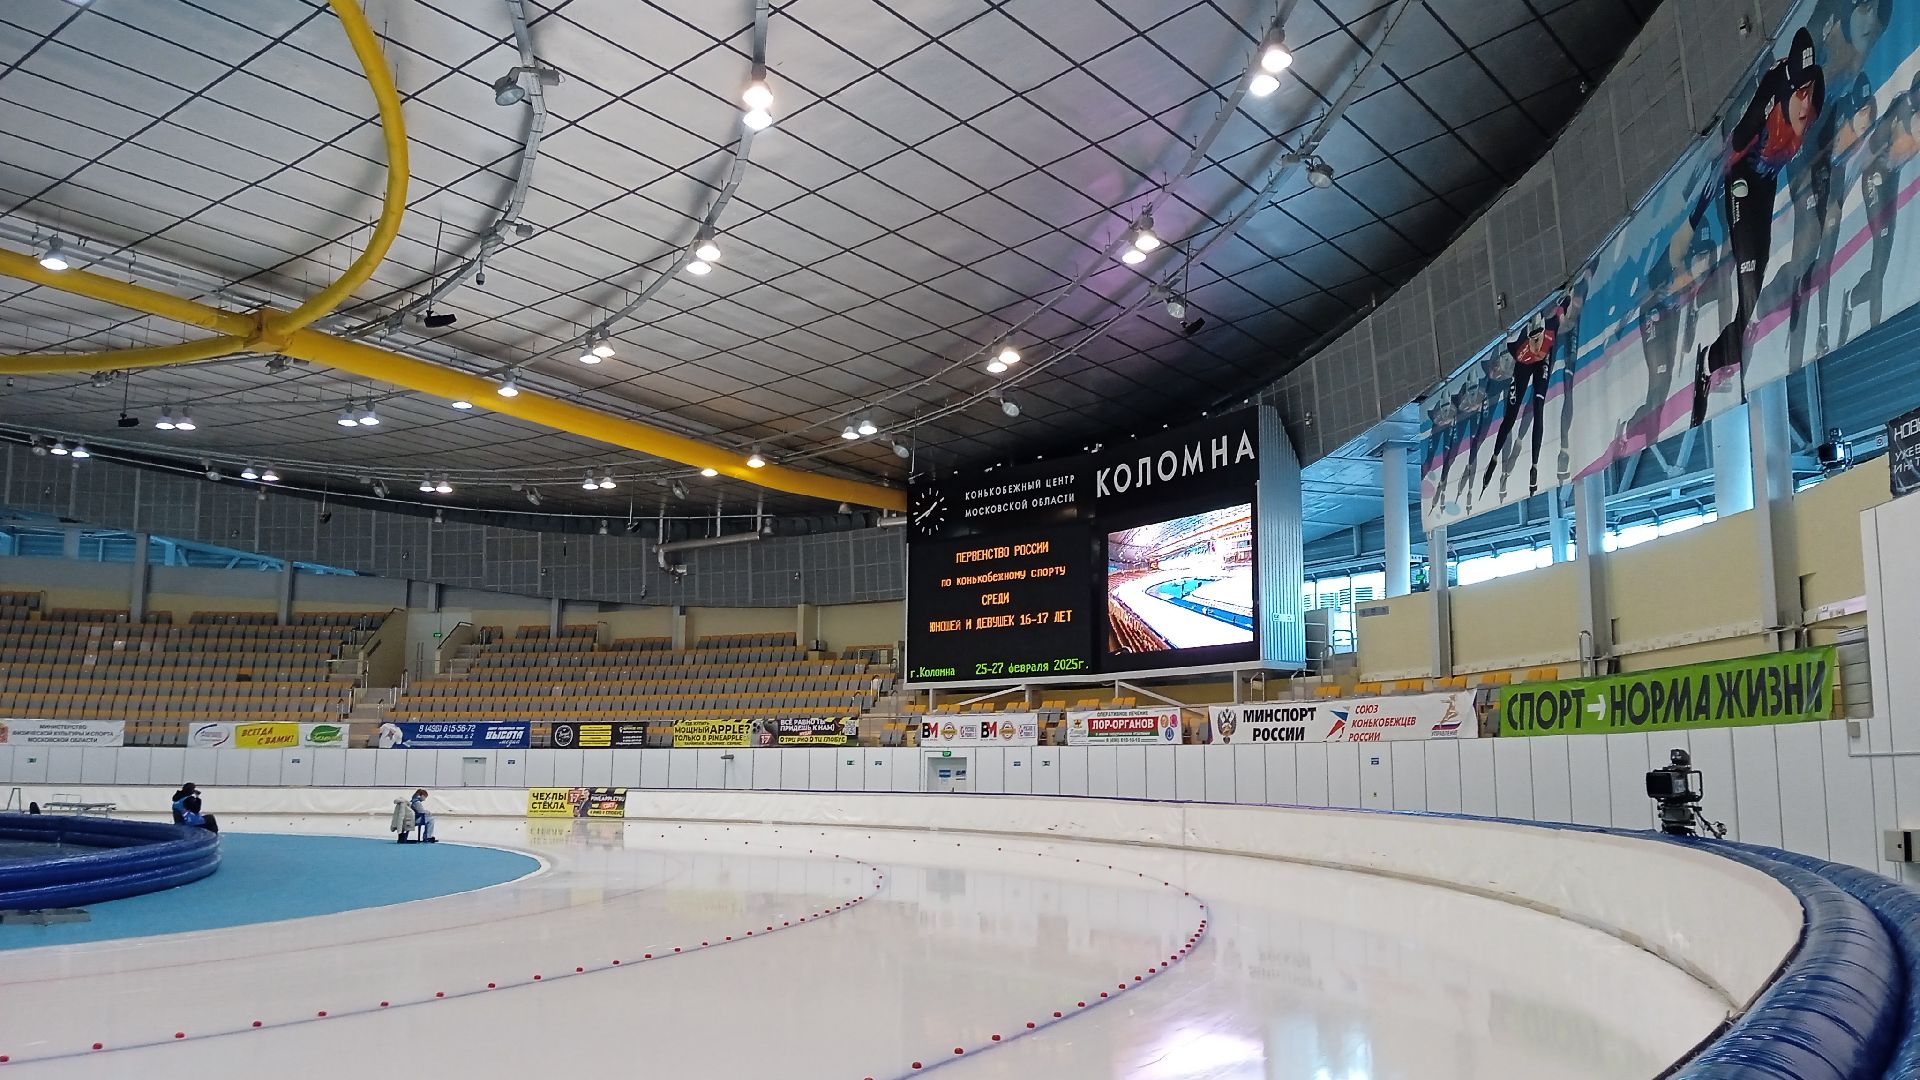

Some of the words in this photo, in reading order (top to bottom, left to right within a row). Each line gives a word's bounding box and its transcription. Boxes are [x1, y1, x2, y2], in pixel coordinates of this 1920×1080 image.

[1096, 429, 1255, 498] КОЛОМНА
[965, 478, 1041, 500] КОНЬКОБЕЖНЫЙ
[1046, 474, 1075, 488] ЦЕНТР
[965, 499, 1028, 518] МОСКОВСКОЙ
[1032, 493, 1075, 508] ОБЛАСТИ
[956, 546, 1009, 563] ПЕРВЕНСТВО
[1014, 541, 1049, 557] РОССИИ
[941, 578, 952, 588] по
[956, 570, 1026, 586] конькобежному
[1031, 566, 1066, 578] спорту
[981, 592, 1009, 606] СРЕДИ
[929, 619, 961, 633] ЮНОШЕЙ
[965, 618, 972, 630] И
[976, 614, 1015, 630] ДЕВУШЕК
[1020, 612, 1049, 626] 16-17
[1054, 610, 1073, 623] ЛЕТ
[910, 666, 955, 679] г.Коломна
[975, 662, 1004, 675] 25-27
[1008, 661, 1049, 674] февраля
[1053, 658, 1089, 672] 2025г.
[1610, 674, 1711, 727] НОРМА
[1716, 660, 1826, 720] ЖИЗНИ
[1243, 706, 1316, 724] МИНСПОРТ
[1355, 704, 1378, 715] СОЮЗ
[1507, 689, 1586, 731] СПОРТ
[675, 726, 709, 734] МОЩНЫЙ
[710, 724, 750, 734] APPLE?
[1092, 718, 1154, 730] ЛОР-ОРГАНОВ
[1351, 716, 1416, 728] КОНЬКОБЕЖЦЕВ
[241, 727, 274, 737] ВСЕГДА
[264, 735, 295, 745] ВАМИ!
[485, 731, 524, 740] ВЫСОТА
[1252, 727, 1305, 742] РОССИИ
[1349, 732, 1381, 742] РОССИИ
